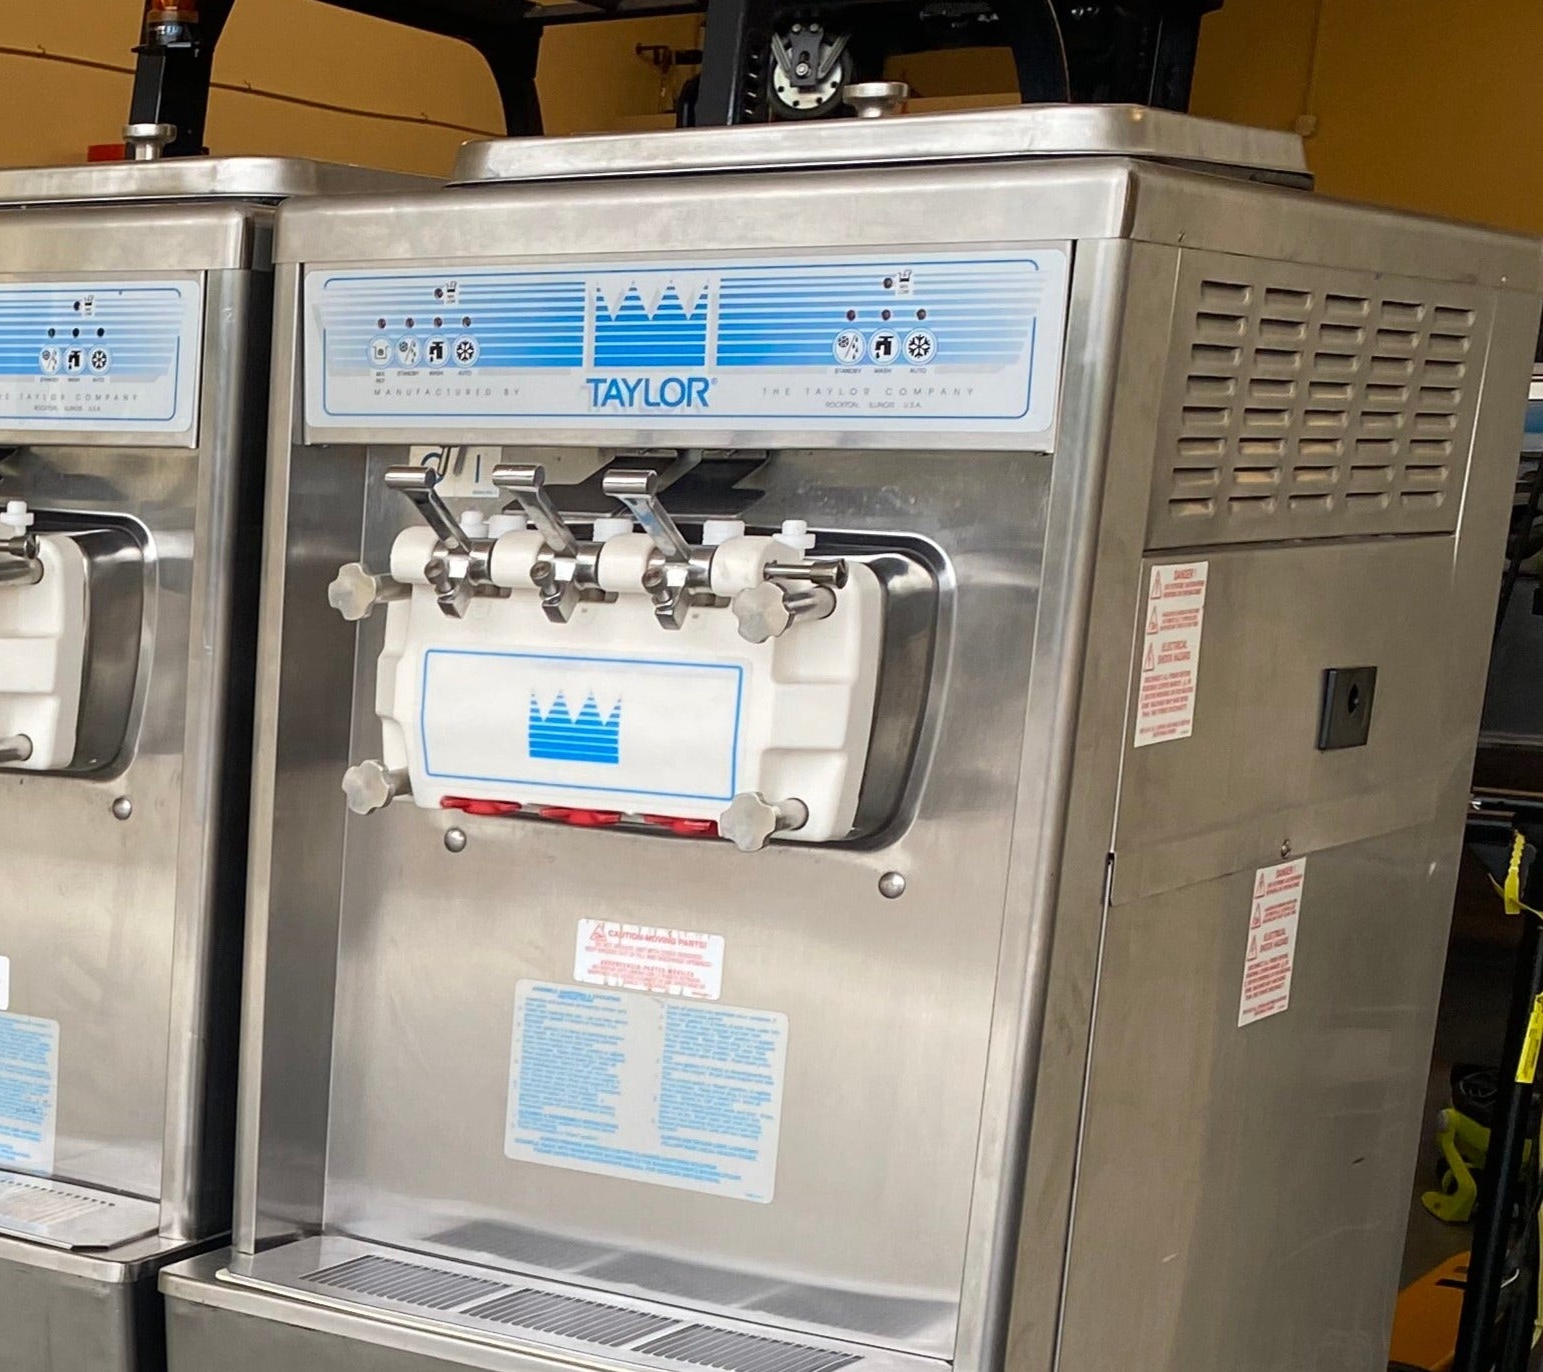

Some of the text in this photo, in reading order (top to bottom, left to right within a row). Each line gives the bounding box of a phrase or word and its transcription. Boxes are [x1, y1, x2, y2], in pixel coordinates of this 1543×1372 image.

[373, 388, 520, 396] MANUFACTURED BY
[586, 376, 709, 408] TAYLOR
[762, 387, 975, 396] THE TAYLOR COMPANY
